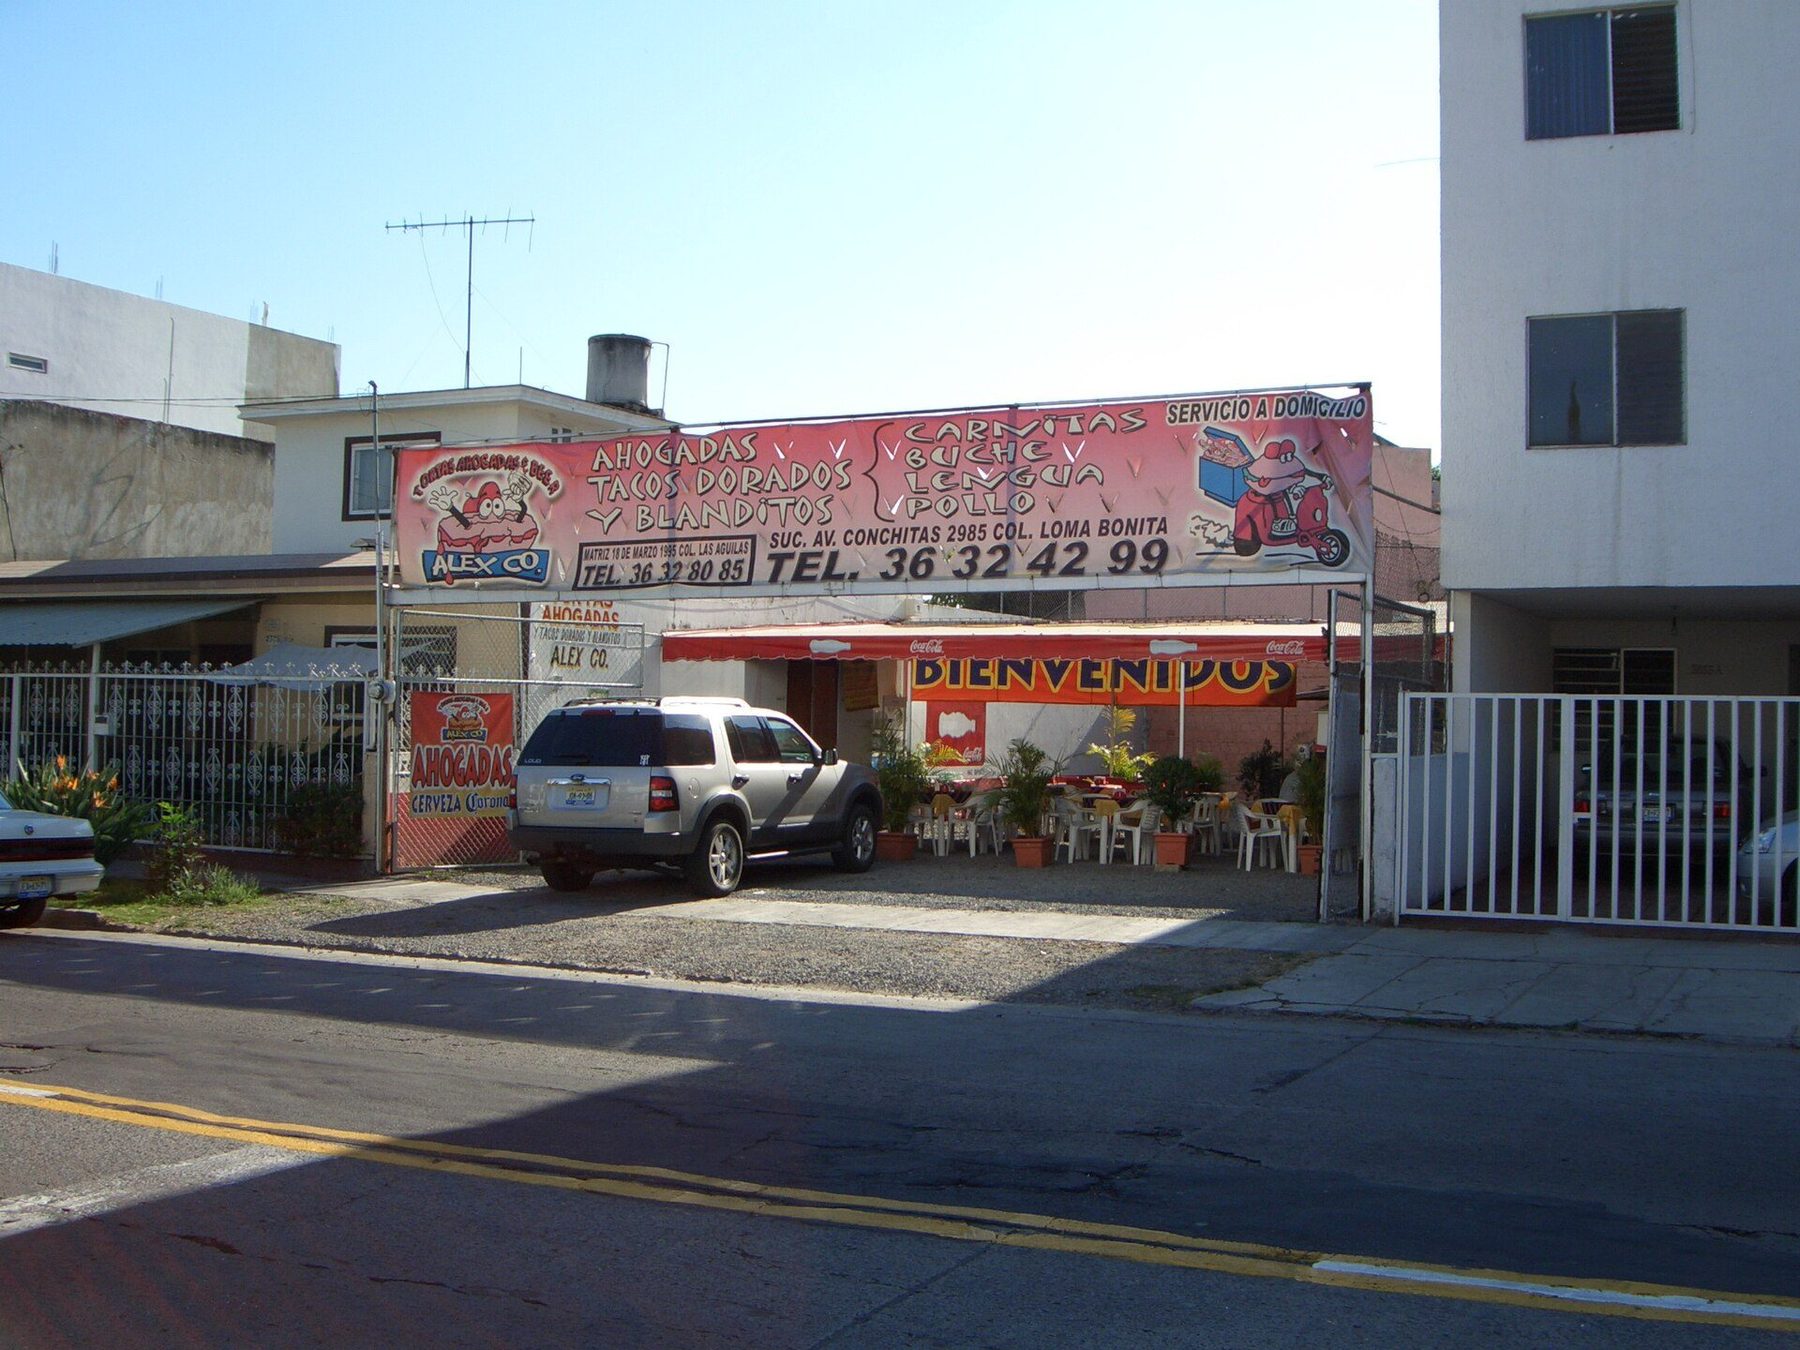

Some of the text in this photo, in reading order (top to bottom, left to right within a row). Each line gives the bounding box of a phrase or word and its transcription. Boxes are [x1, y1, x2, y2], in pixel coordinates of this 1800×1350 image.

[1167, 397, 1365, 424] SERVICIO A DOMICILIO
[592, 432, 758, 471] AHOGADAS
[904, 440, 1051, 470] BUCHE
[587, 459, 853, 504] TACOS DORADOS
[904, 463, 1104, 494] LENGUA
[905, 490, 1036, 519] POLLO
[585, 506, 622, 535] Y
[769, 517, 1168, 549] SUC. AV. CONCHITAS 2985 COL. LOMA BONITA
[432, 551, 541, 576] ALEX CO.
[584, 548, 610, 561] MATRIZ
[621, 547, 630, 560] DE
[632, 545, 658, 559] MARZO
[678, 544, 696, 557] COL.
[699, 543, 713, 556] LAS
[713, 541, 749, 556] AGUILAS
[766, 537, 1169, 583] TEL. 36 32 42 99
[582, 557, 745, 586] TEL. 36 32 80 85
[542, 605, 619, 629] AHOGADAS
[551, 645, 608, 668] ALEX CO.
[914, 657, 1294, 693] BIENVENIDOS
[412, 744, 512, 788] AHOGADAS
[412, 793, 510, 813] CERVEZA Corona
